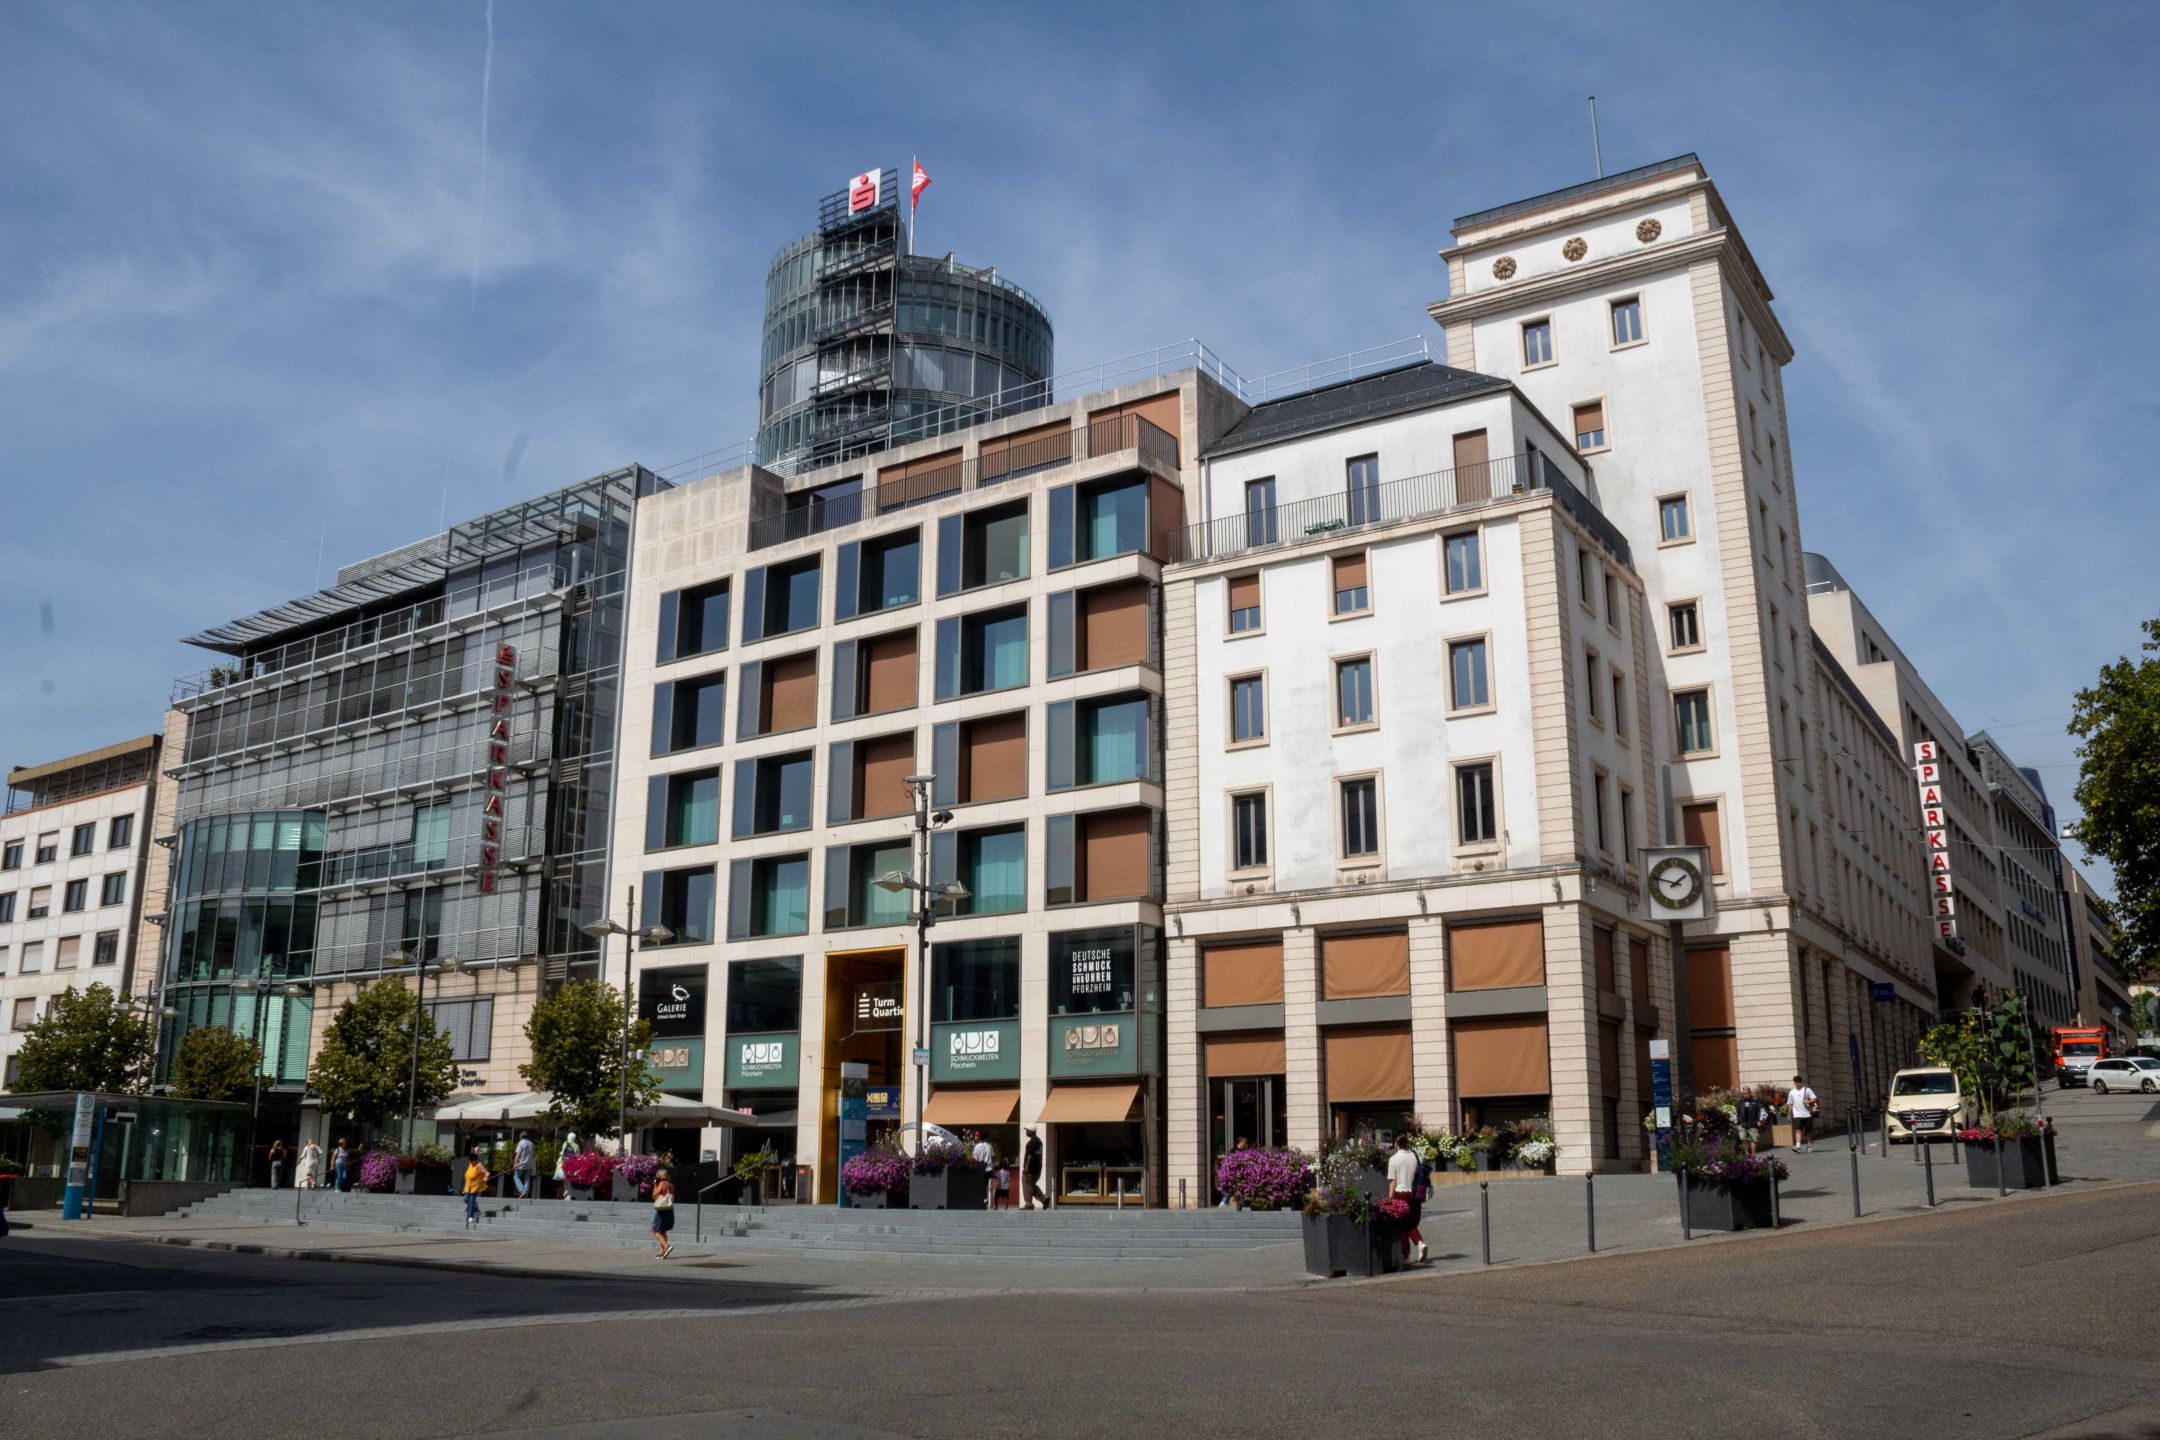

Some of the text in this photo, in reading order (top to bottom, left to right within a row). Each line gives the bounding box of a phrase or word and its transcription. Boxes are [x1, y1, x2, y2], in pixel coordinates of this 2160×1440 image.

[481, 669, 511, 893] SPARKASSE
[1920, 743, 1951, 937] SPARKASSE
[1072, 949, 1111, 962] DEUTSCHE
[1072, 960, 1111, 973] SCHMUCK
[1085, 971, 1111, 983] UHREN
[1072, 983, 1111, 994] PFORZHEIM
[657, 1003, 687, 1013] GALERIE
[873, 998, 895, 1007] Turm
[873, 1006, 904, 1018] Quartie
[951, 1053, 999, 1062] SCHMUCKWELTEN
